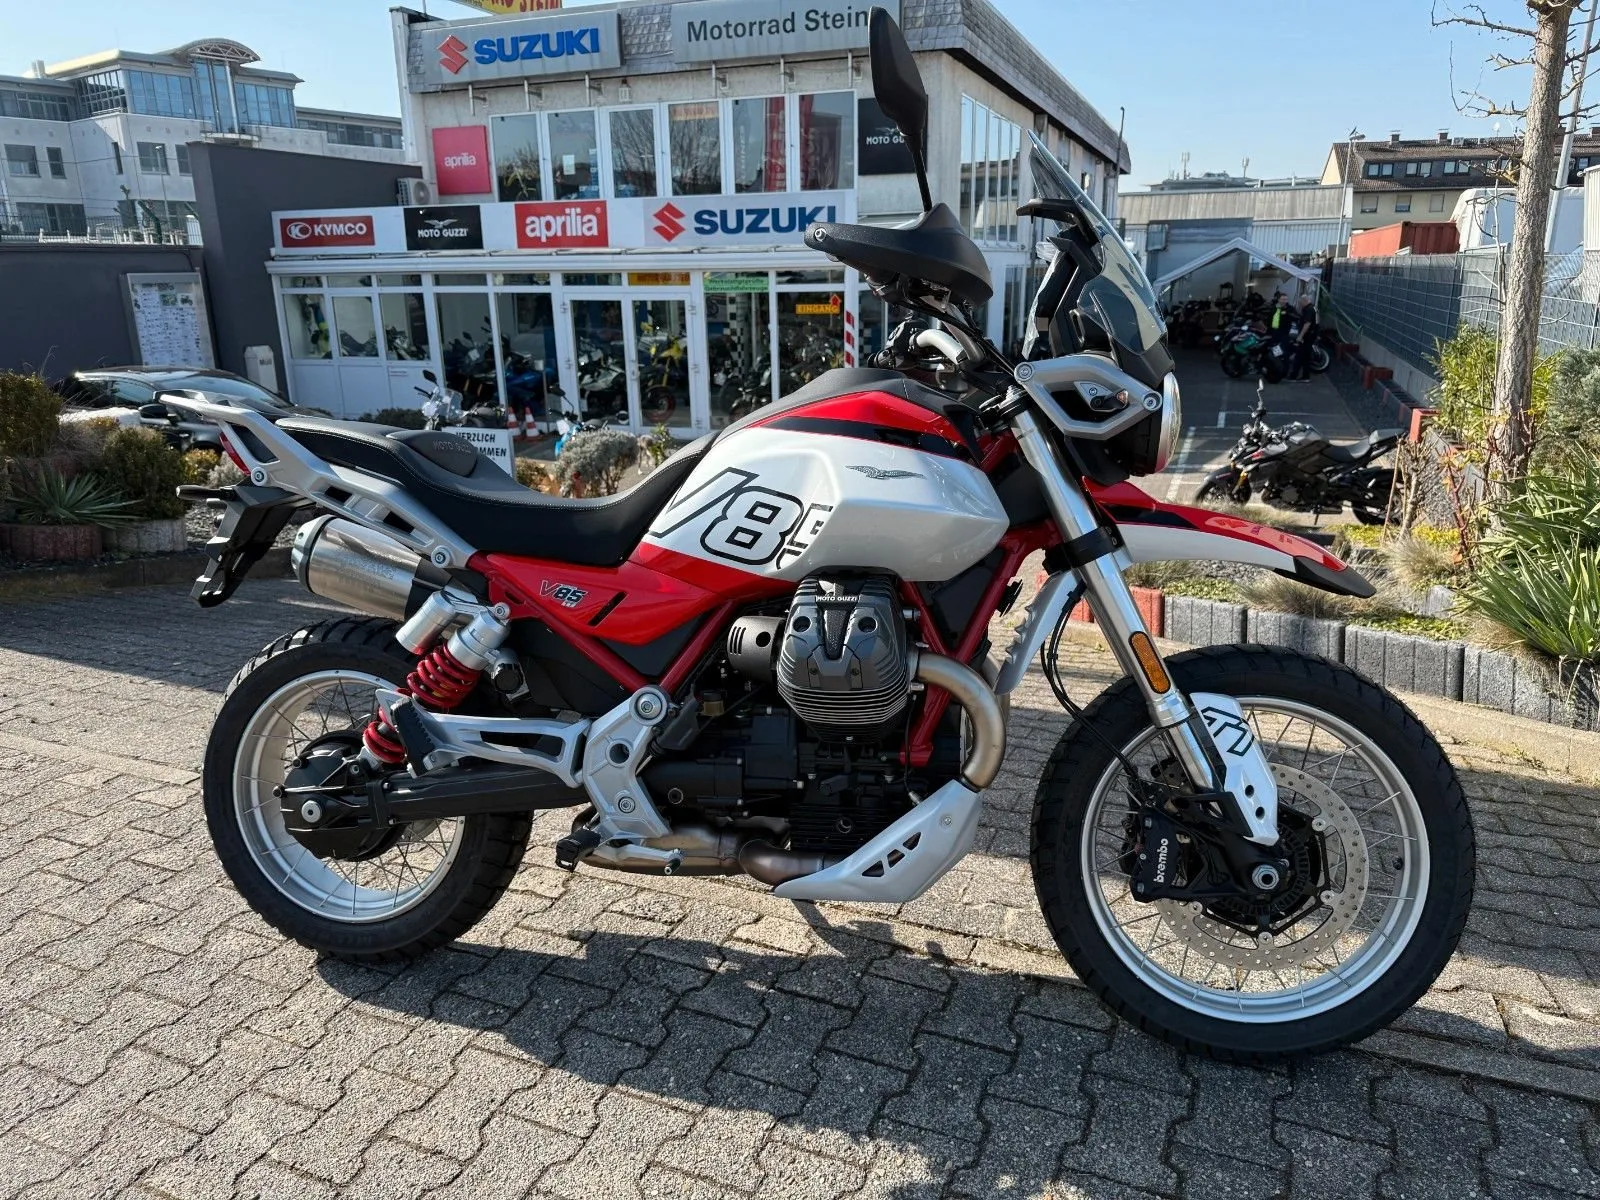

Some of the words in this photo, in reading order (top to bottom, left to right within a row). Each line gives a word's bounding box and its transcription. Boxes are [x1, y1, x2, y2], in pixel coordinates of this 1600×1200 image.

[687, 11, 796, 43] Motorrad
[804, 6, 868, 32] Stein
[474, 28, 600, 65] SUZUKI
[866, 136, 890, 145] MOTO
[444, 152, 477, 169] aprilia
[314, 222, 367, 236] KYMCO
[417, 229, 440, 238] MOTO
[442, 228, 468, 238] GUZZI
[525, 207, 599, 243] aprilia
[693, 205, 836, 235] SUZUKI
[539, 579, 589, 602] V85
[1153, 837, 1169, 883] brembo
